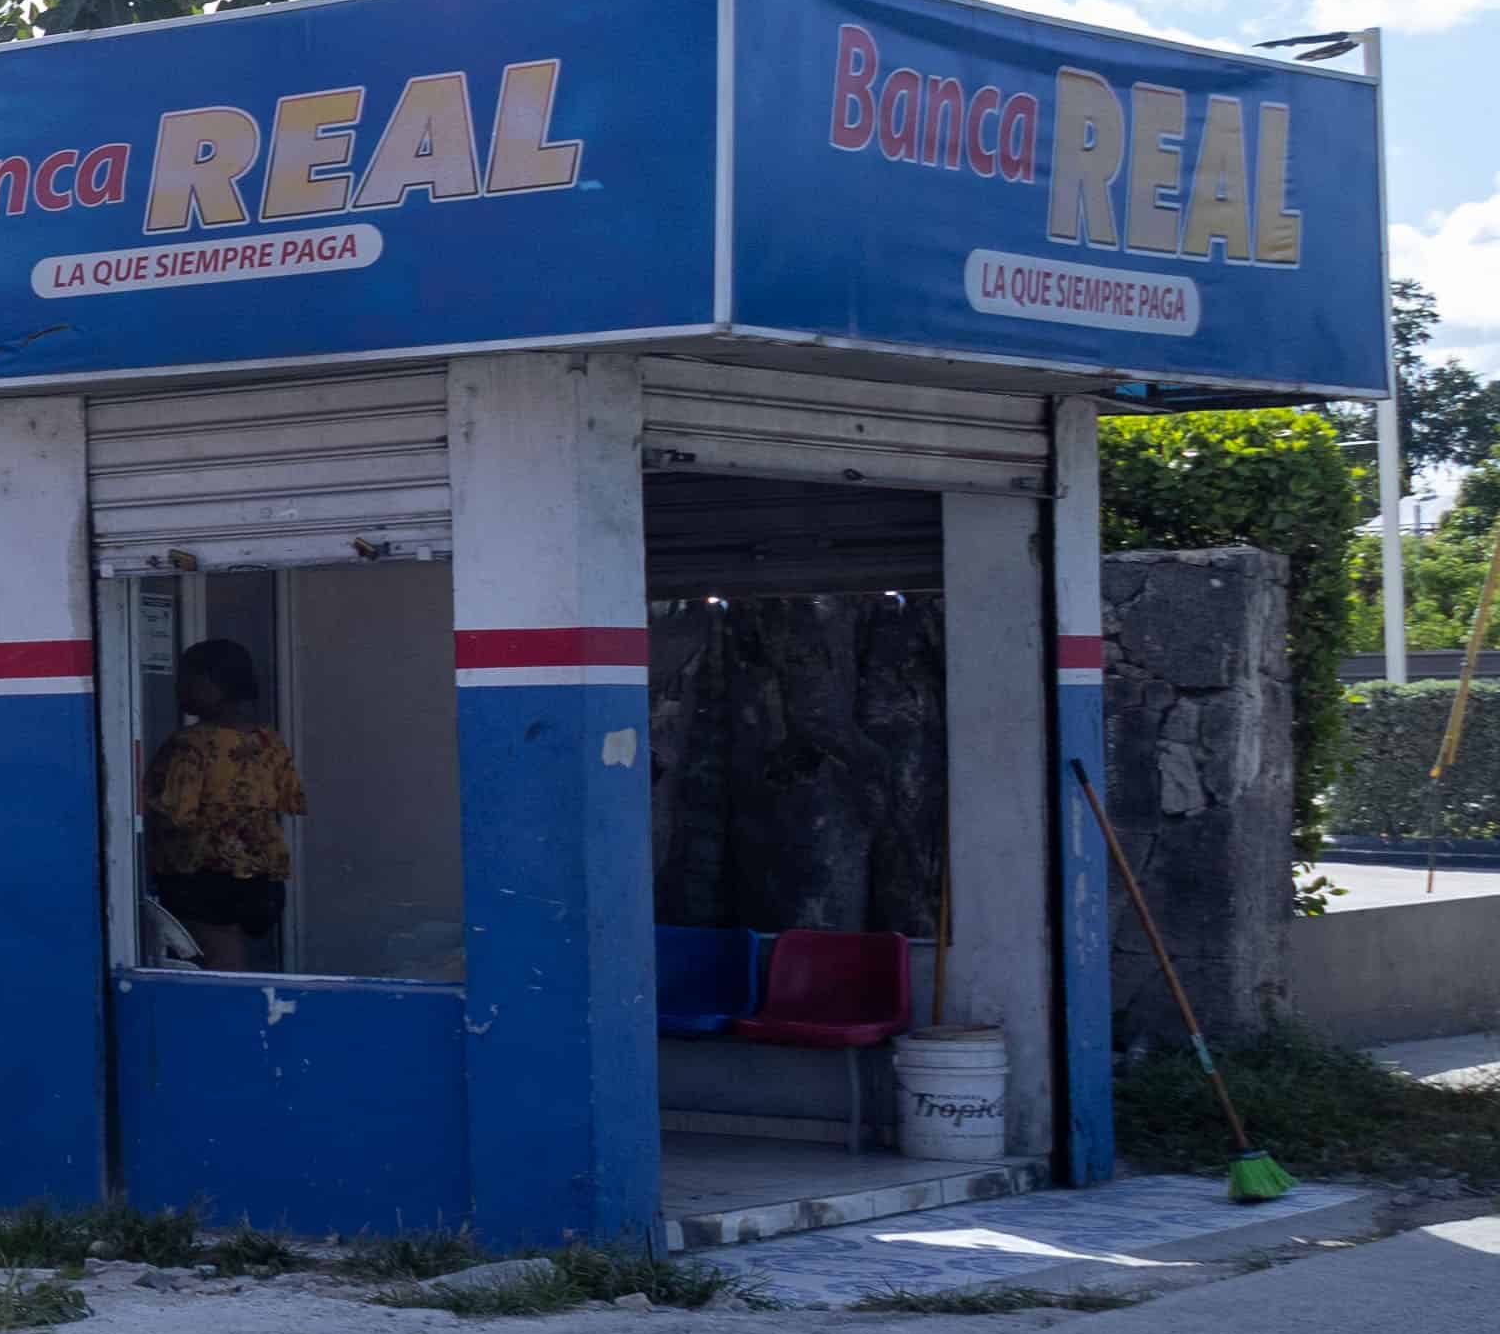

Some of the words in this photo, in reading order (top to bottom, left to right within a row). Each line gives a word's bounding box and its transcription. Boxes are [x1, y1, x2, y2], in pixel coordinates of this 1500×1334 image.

[142, 58, 585, 235] REAL
[829, 23, 1038, 184] Banca
[1046, 66, 1302, 268] REAL
[53, 263, 85, 288] LA
[92, 256, 149, 286] QUE
[154, 241, 274, 279] SIEMPRE
[280, 234, 358, 265] PAGA
[981, 263, 1006, 299] LA
[1011, 267, 1052, 307] QUE
[1056, 273, 1135, 316] SIEMPRE
[1139, 284, 1187, 322] PAGA
